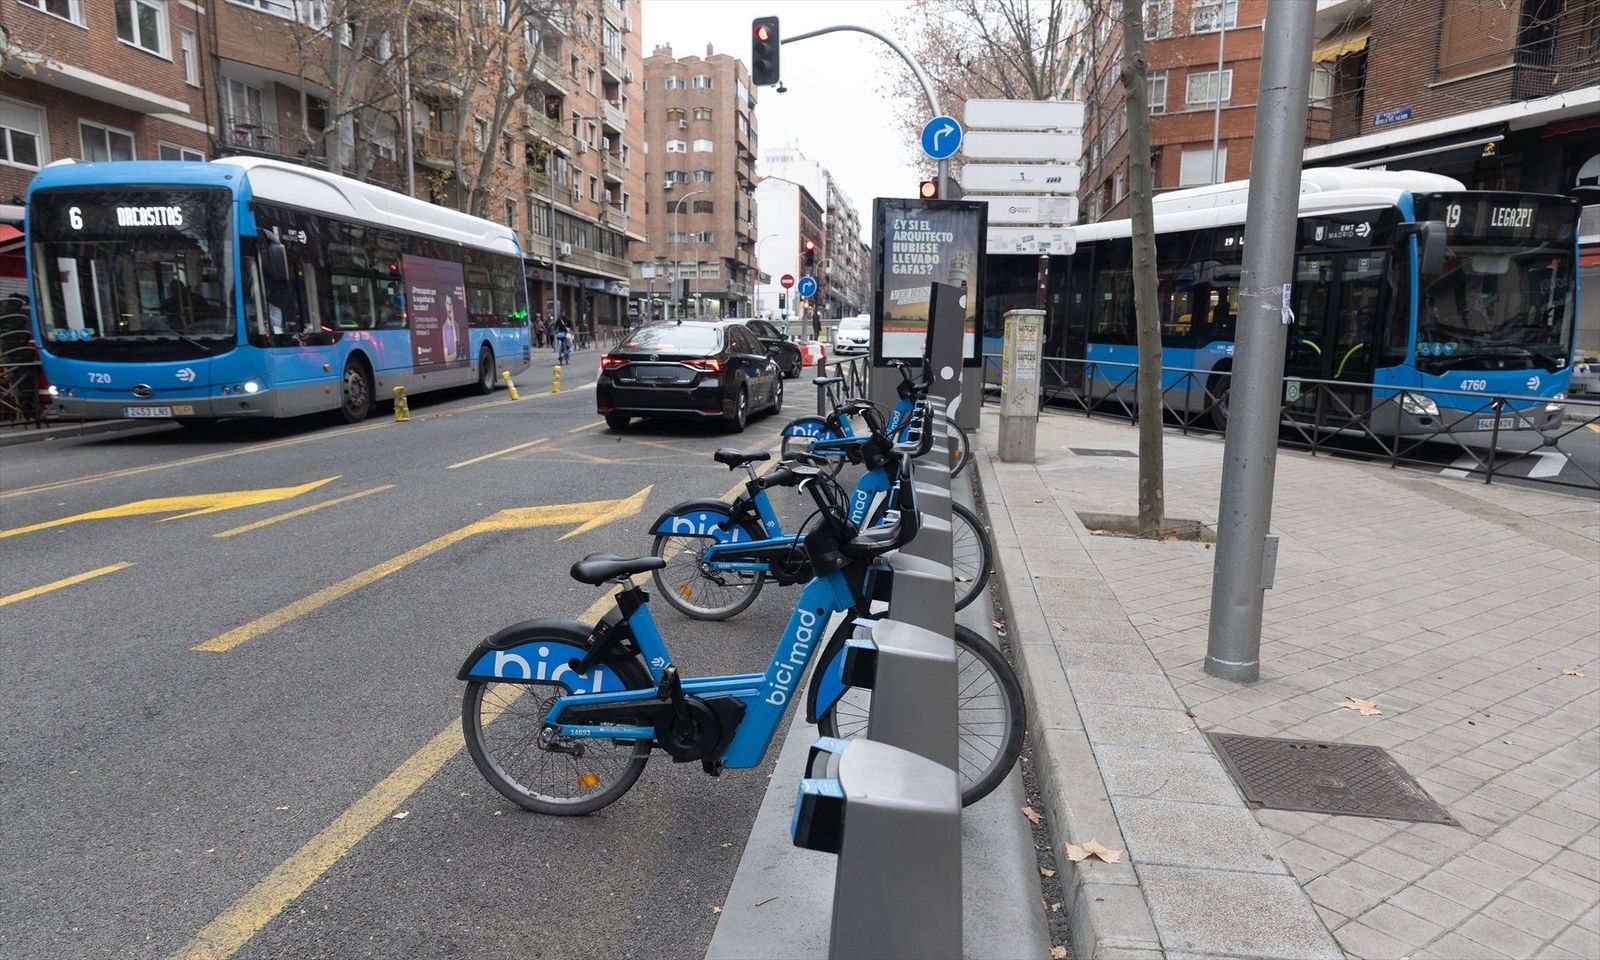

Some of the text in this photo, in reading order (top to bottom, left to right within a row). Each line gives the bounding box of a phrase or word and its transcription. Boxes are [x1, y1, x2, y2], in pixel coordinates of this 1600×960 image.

[69, 206, 183, 230] 6 ORCASITAS
[1445, 204, 1533, 228] 19 LEGAZPI
[893, 219, 931, 231] ¿Y SI EL
[1340, 223, 1355, 232] EMT
[893, 231, 954, 243] ARQUITECTO
[1328, 231, 1354, 239] MADRID
[892, 242, 939, 253] HUBIESE
[892, 253, 940, 264] LLEVADO
[892, 264, 933, 275] GAFAS?
[87, 372, 112, 384] 720
[1460, 379, 1487, 391] 4760
